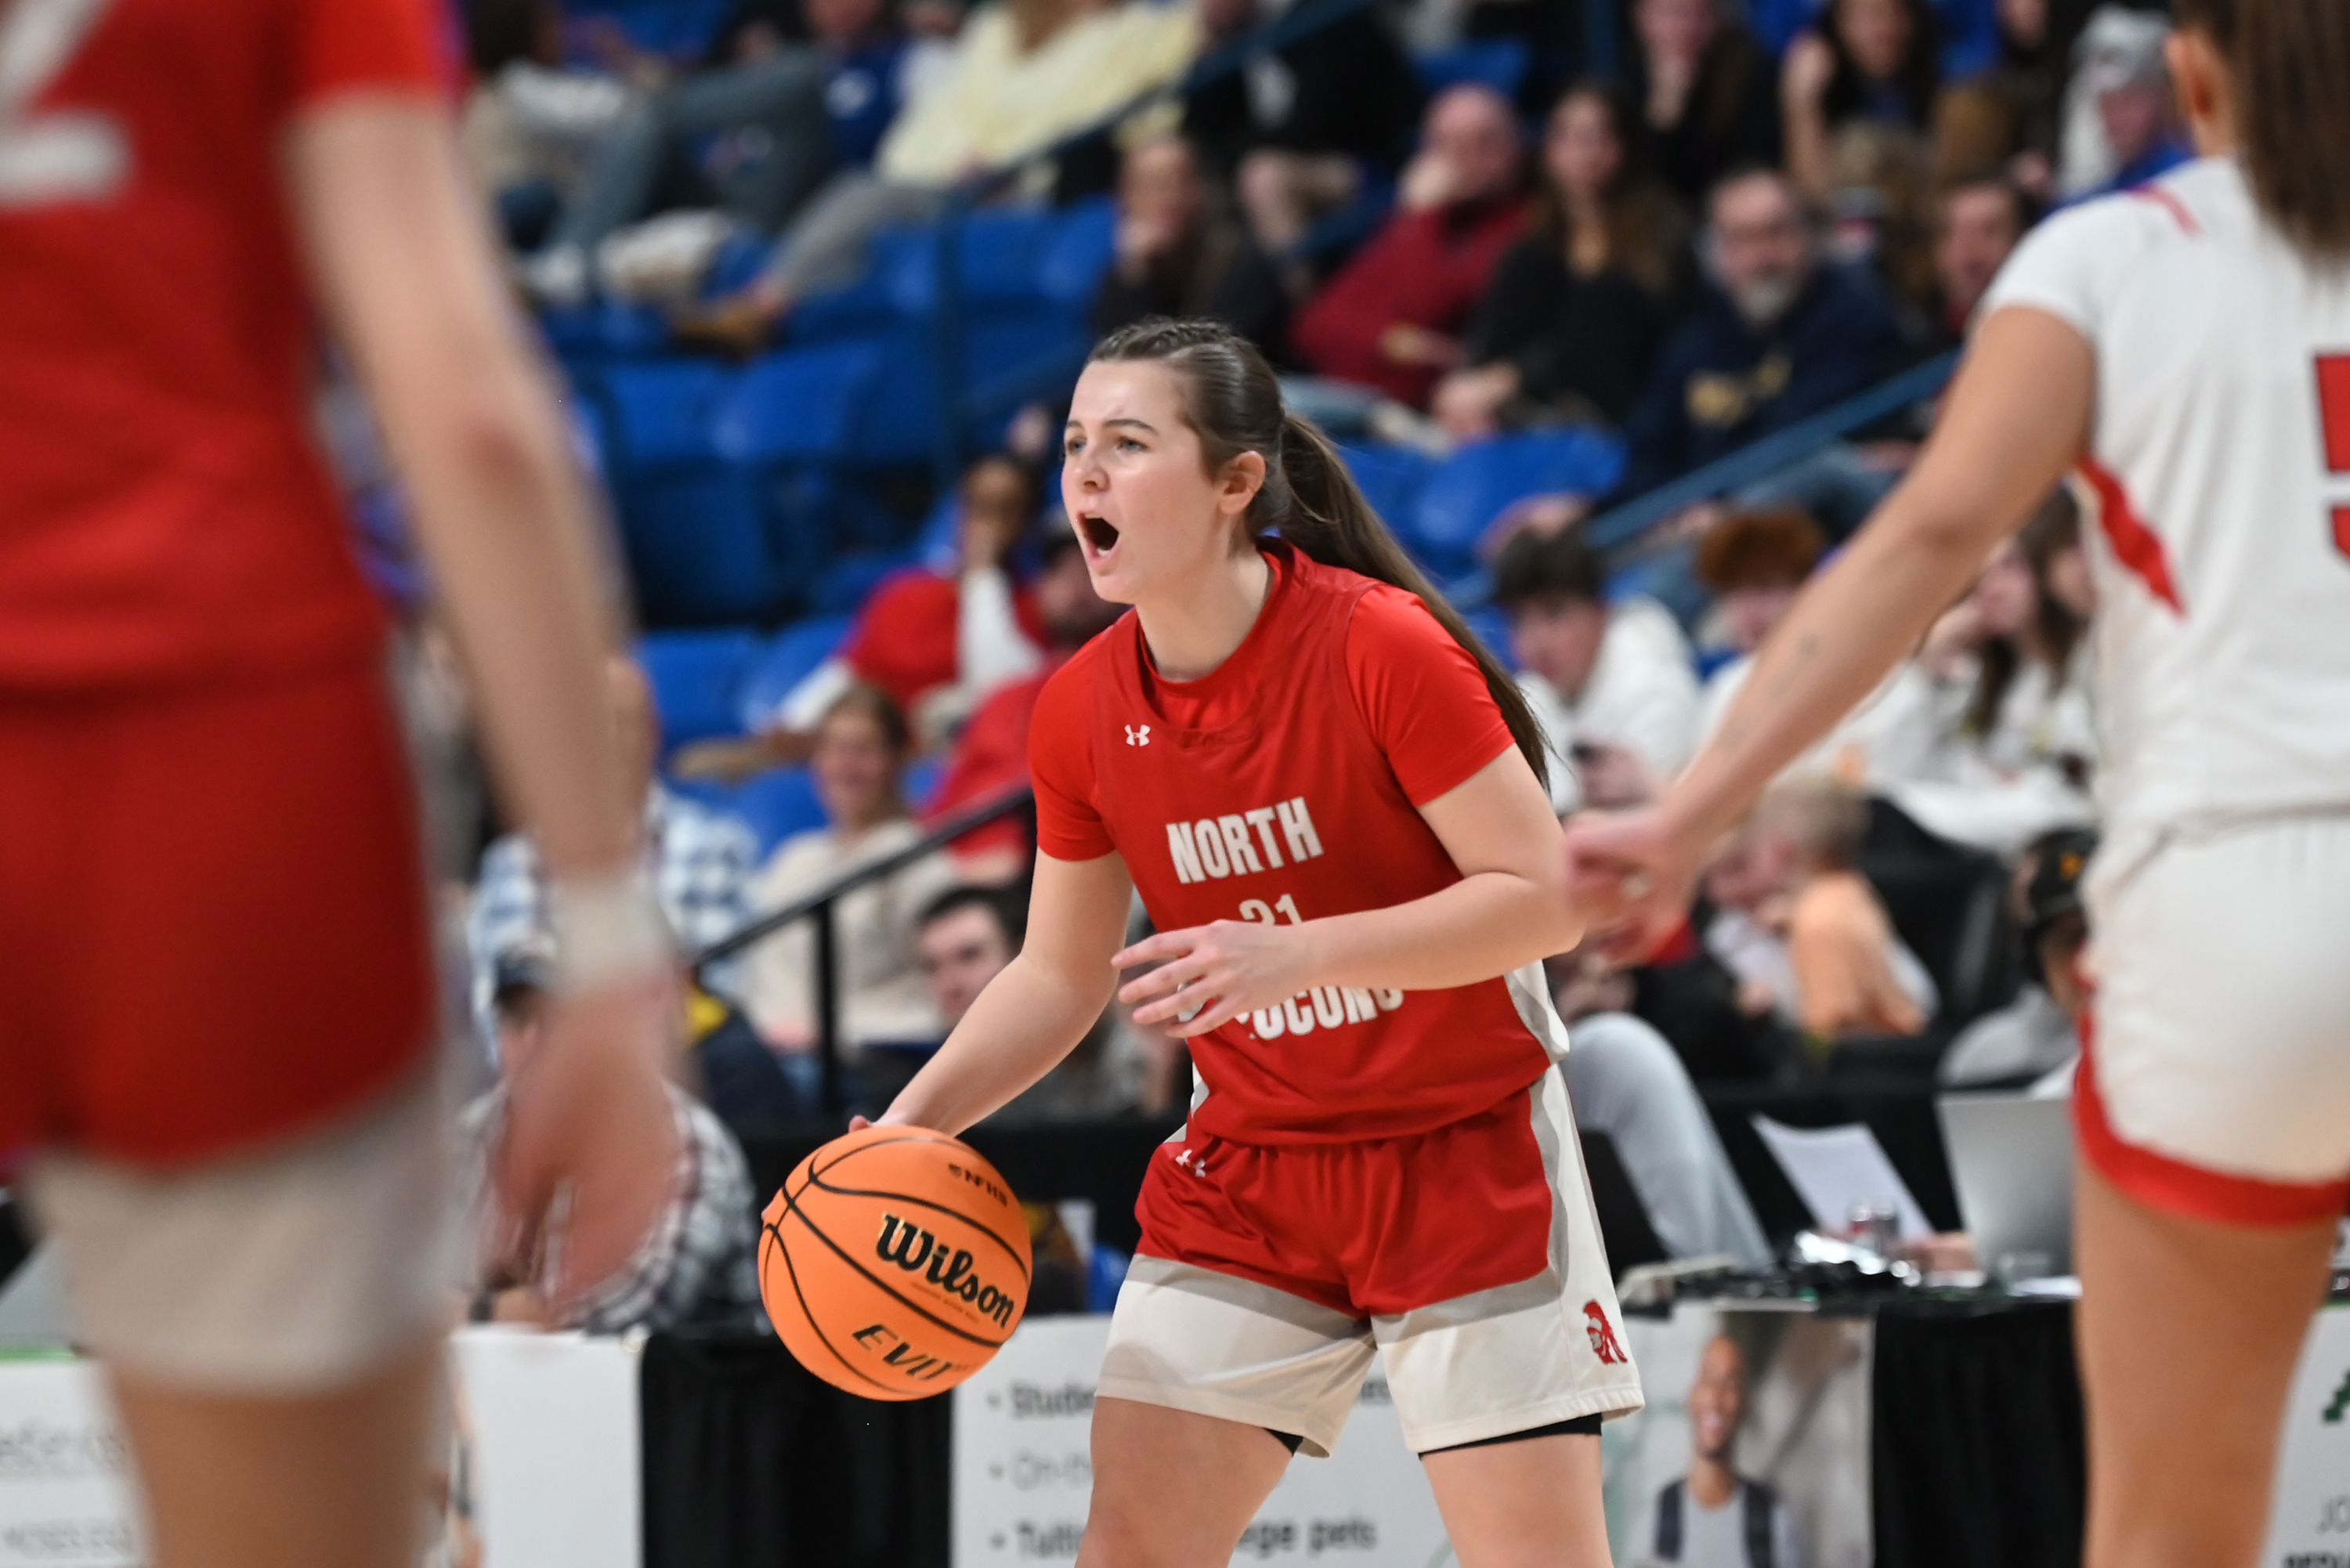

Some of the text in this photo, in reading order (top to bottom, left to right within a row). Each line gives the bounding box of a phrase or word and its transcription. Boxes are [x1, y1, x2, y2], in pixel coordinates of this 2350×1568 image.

[1166, 796, 1324, 884] NORTH
[1235, 985, 1404, 1040] OCON
[876, 1212, 1015, 1328] Wilson
